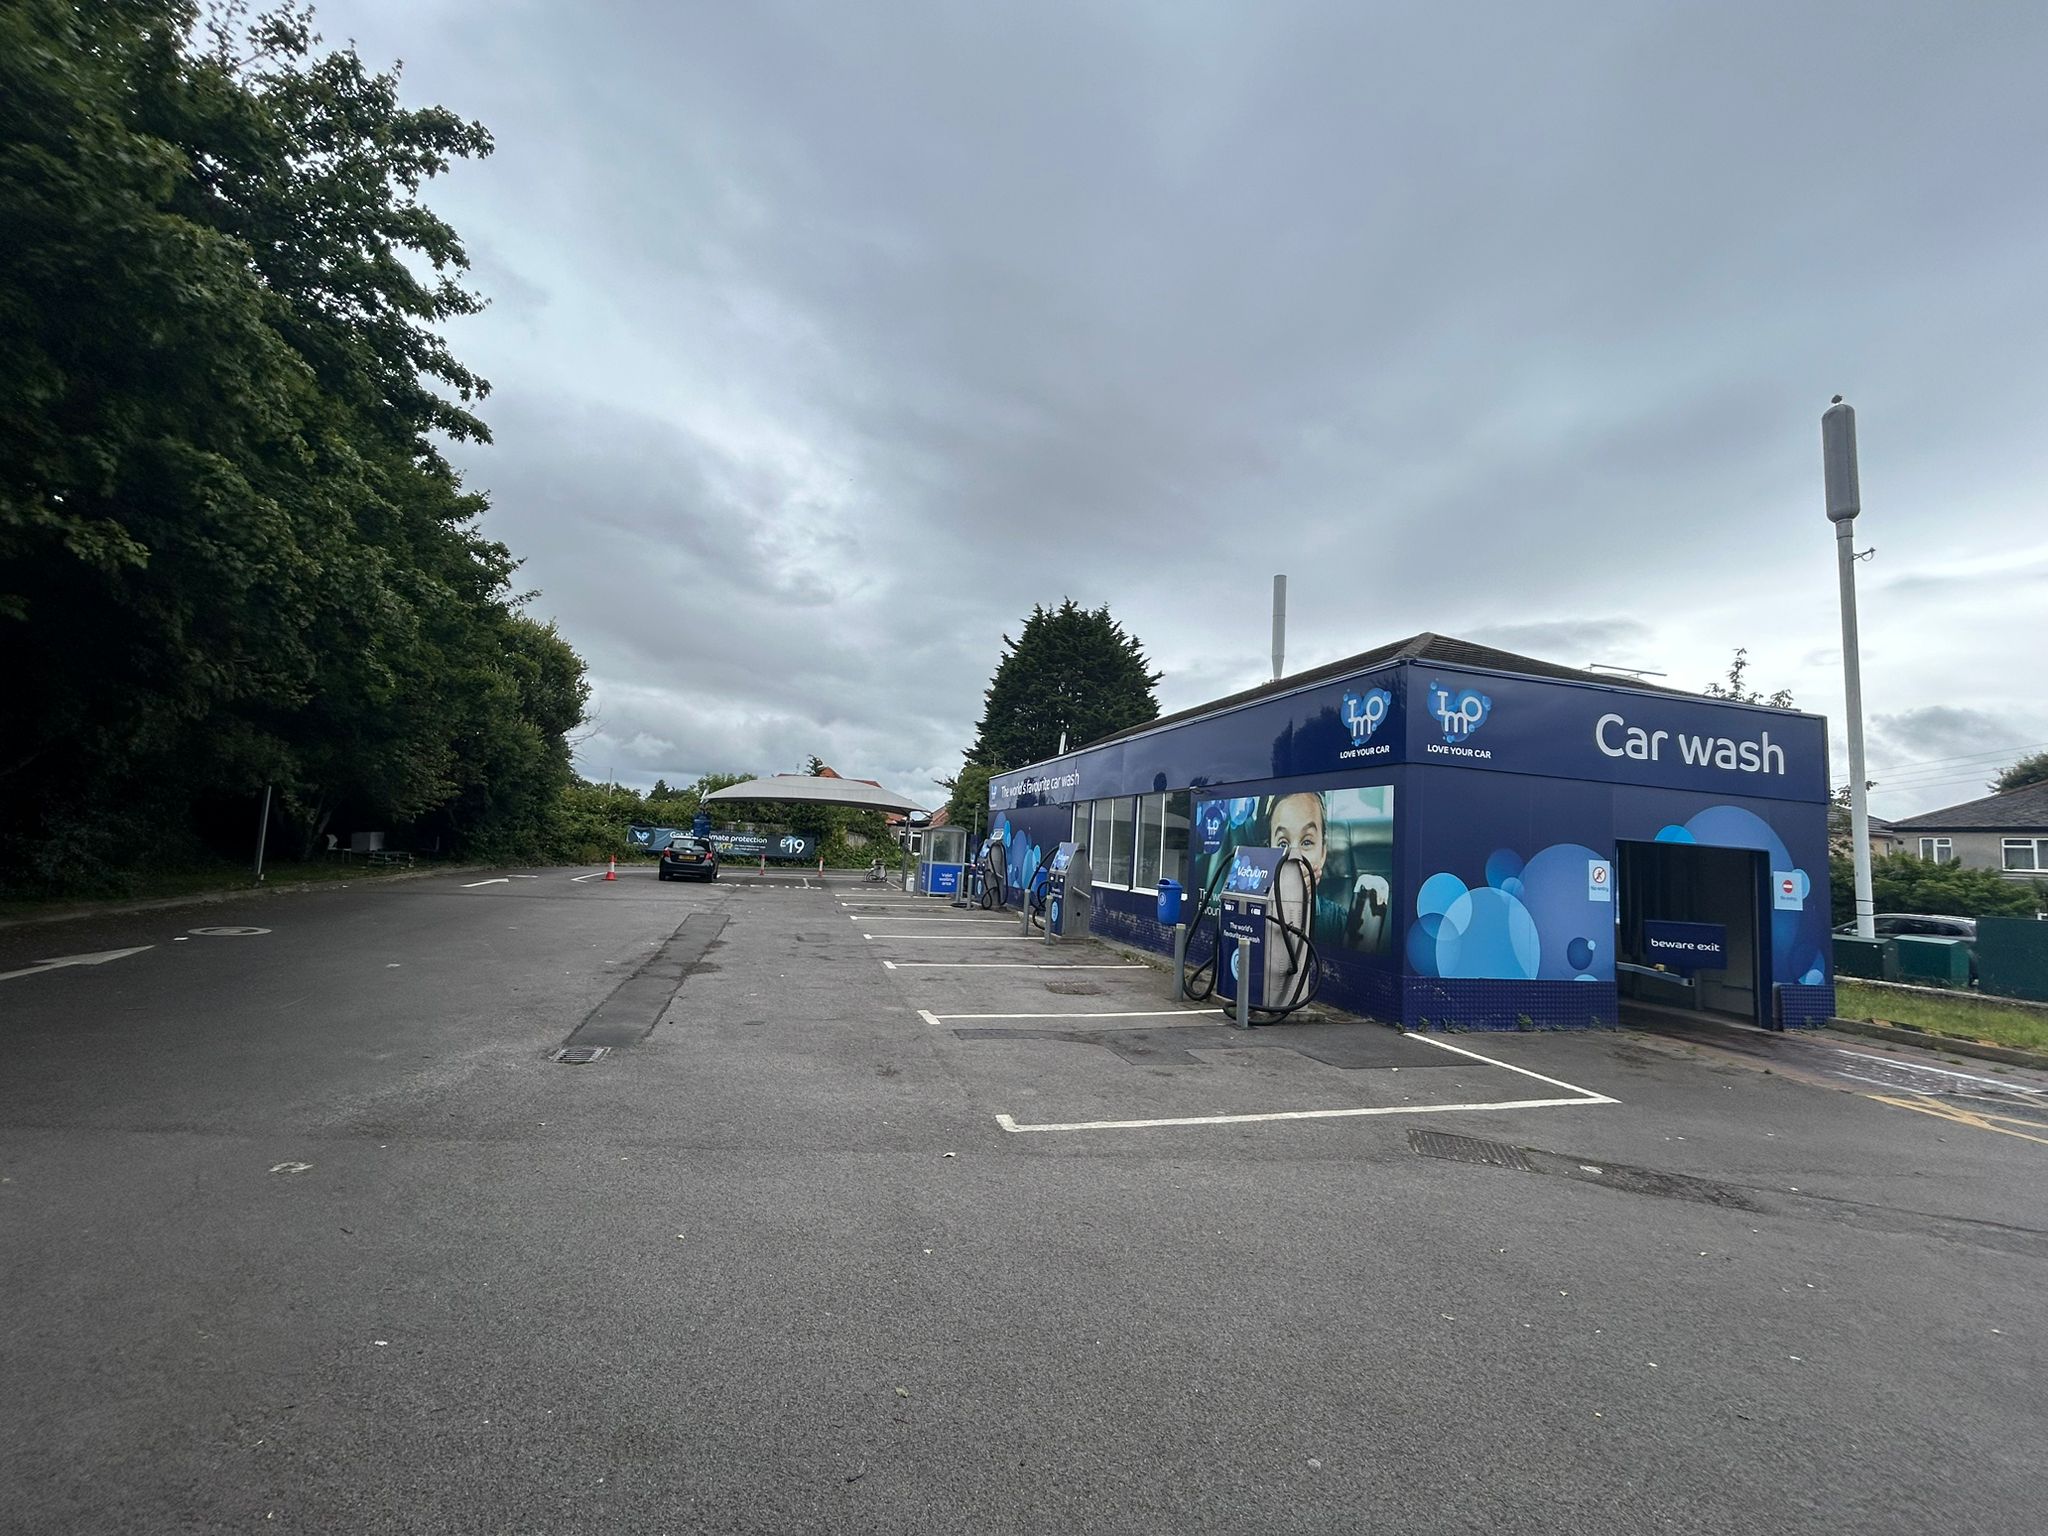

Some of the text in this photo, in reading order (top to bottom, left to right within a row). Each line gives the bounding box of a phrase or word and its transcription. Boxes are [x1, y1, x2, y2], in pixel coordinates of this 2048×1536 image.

[1595, 712, 1785, 775] Car wash
[1340, 744, 1390, 759] LOVE YOUR CAR
[1427, 744, 1492, 759] LOVE YOUR CAR
[1001, 785, 1009, 797] The
[1009, 780, 1026, 796] world's
[1026, 776, 1050, 793] favourite
[1050, 775, 1060, 789] car
[1061, 768, 1080, 786] wash
[731, 834, 768, 844] protection
[780, 838, 805, 854] £19
[1237, 866, 1268, 879] Vacuum
[1651, 938, 1720, 952] beware exit
